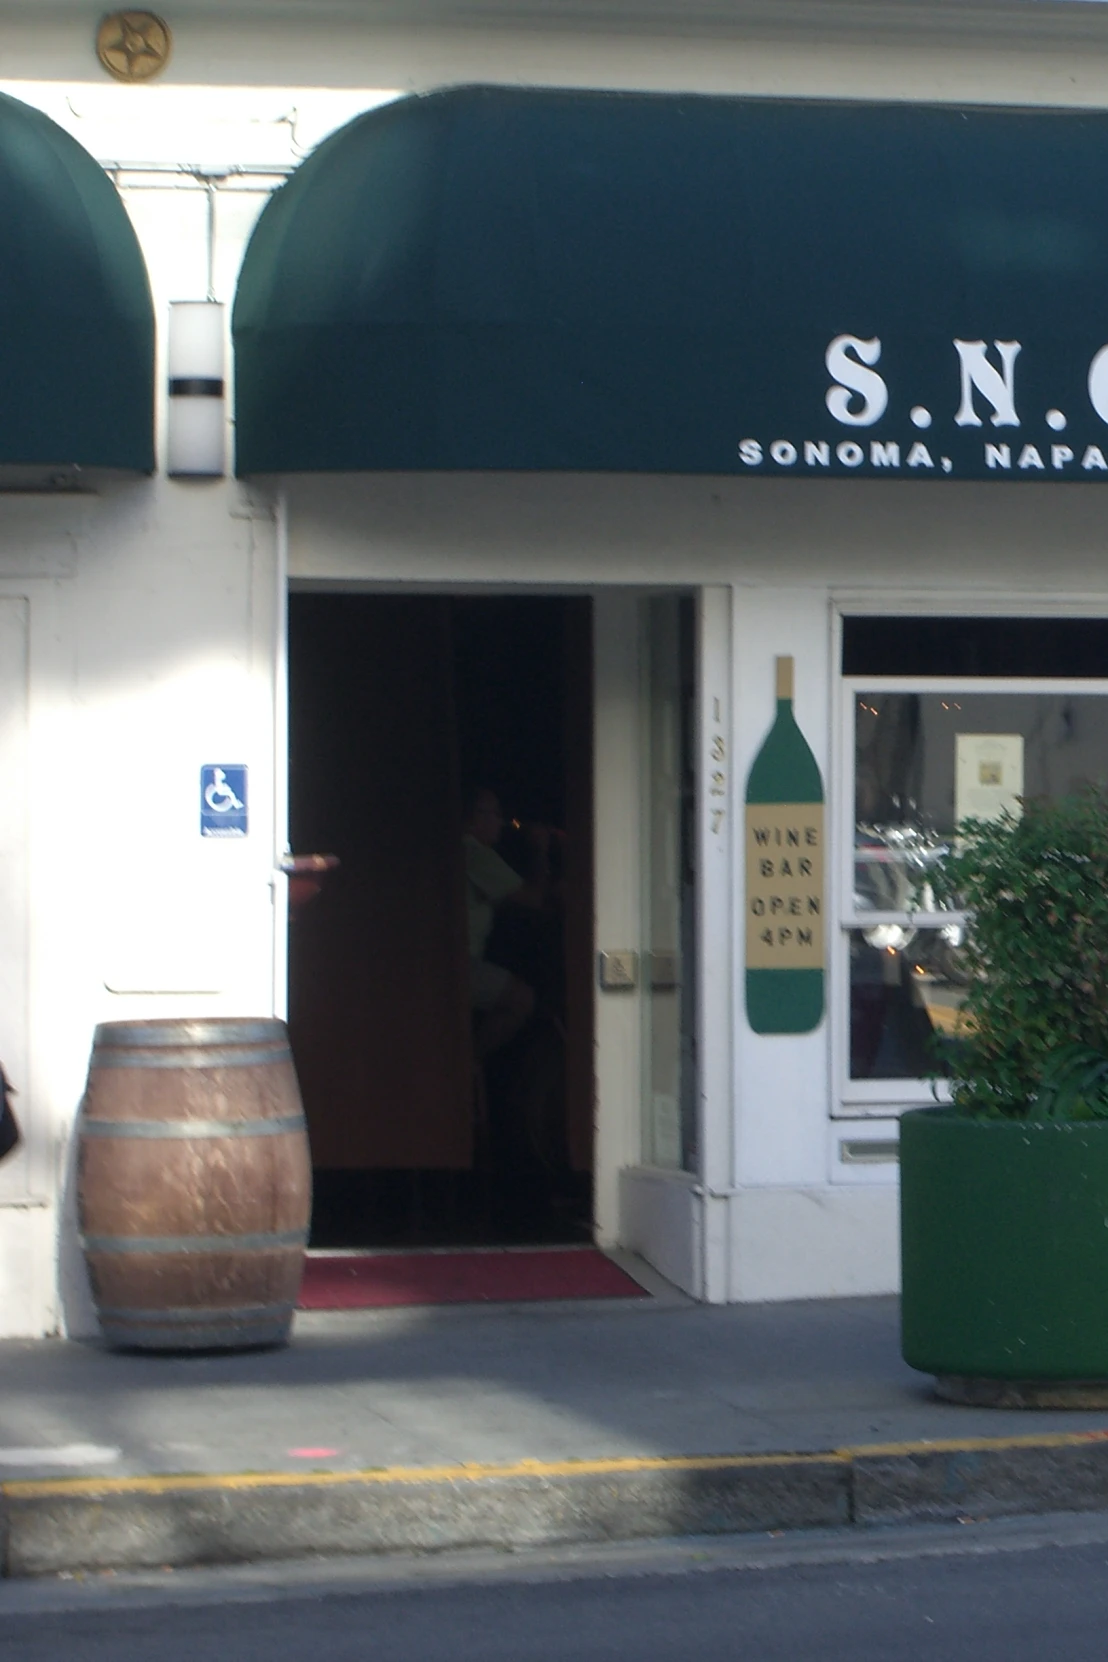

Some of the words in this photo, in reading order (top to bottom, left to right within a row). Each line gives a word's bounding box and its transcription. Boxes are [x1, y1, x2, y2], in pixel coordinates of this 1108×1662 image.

[738, 439, 954, 473] SONOMA,
[753, 827, 818, 848] WINE
[760, 858, 813, 878] BAR
[752, 896, 821, 917] OPEN
[760, 927, 813, 948] 4PM
